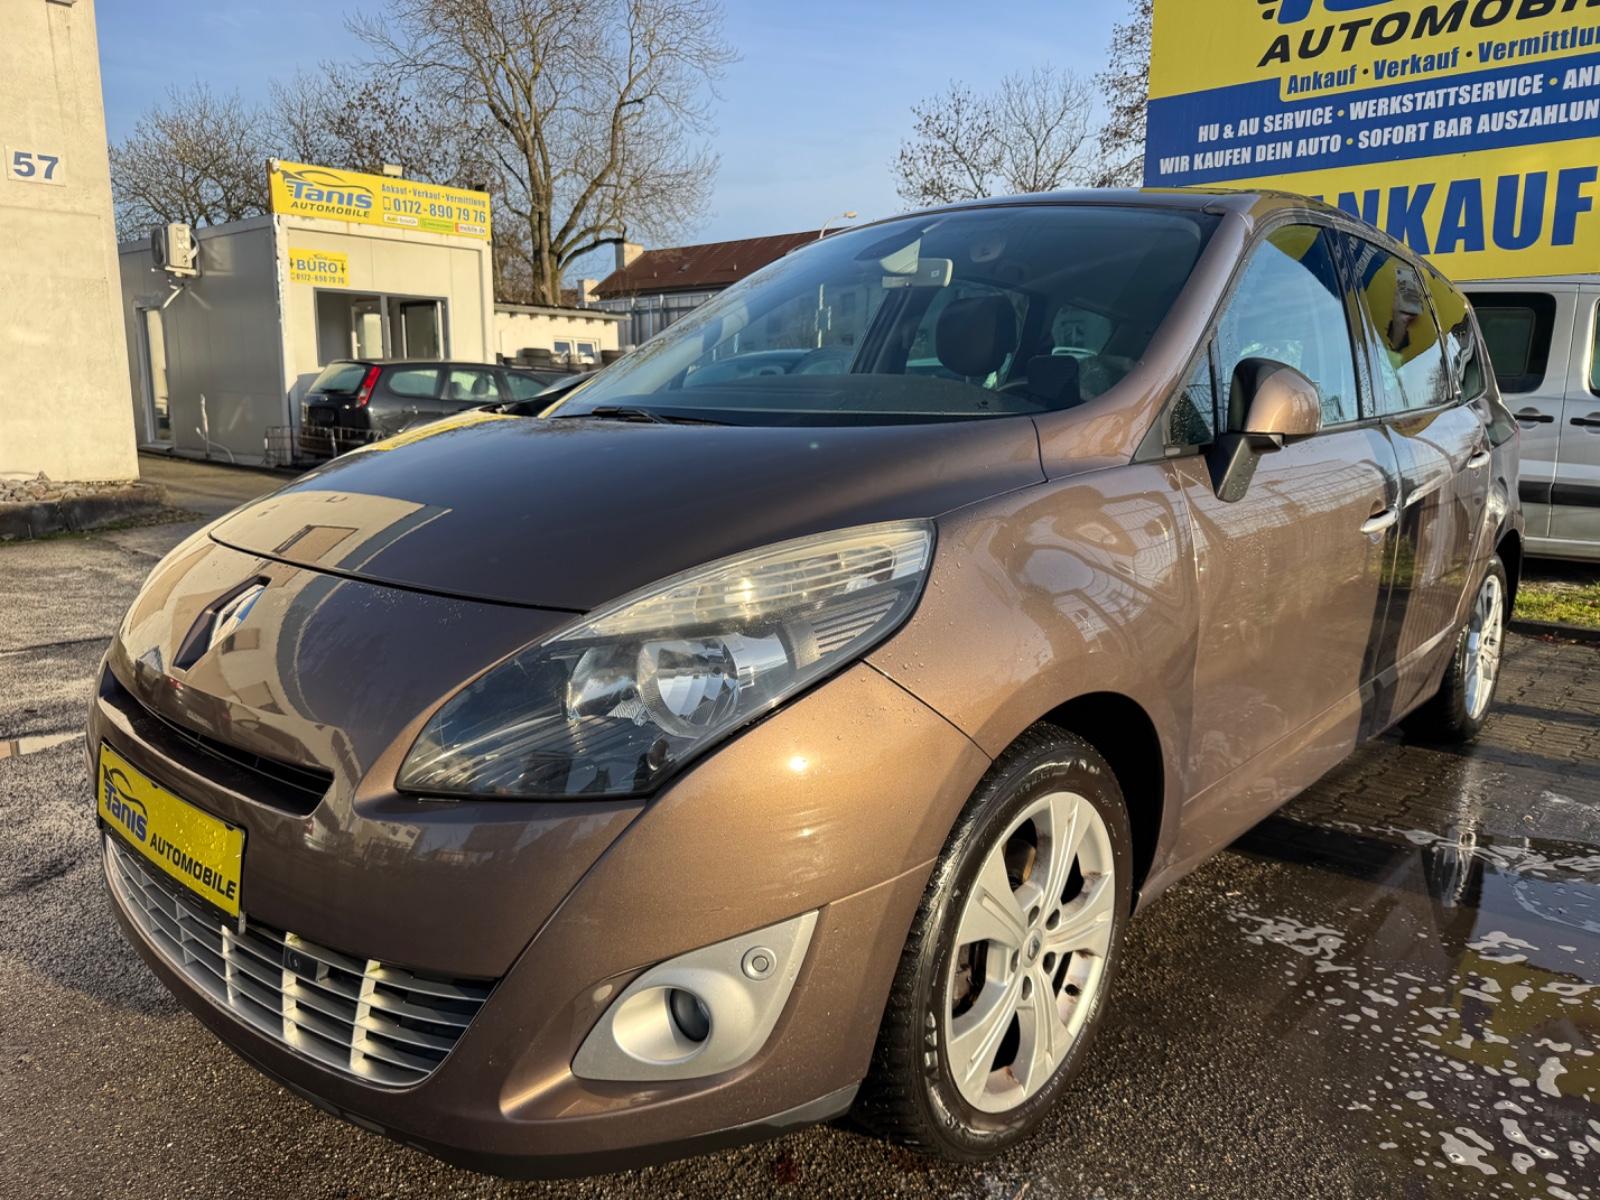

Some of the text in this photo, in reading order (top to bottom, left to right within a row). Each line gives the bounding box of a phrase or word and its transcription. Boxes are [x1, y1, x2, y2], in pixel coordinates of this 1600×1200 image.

[1287, 65, 1357, 95] Ankauf
[1374, 46, 1461, 80] Verkauf
[1198, 123, 1220, 143] HU
[1223, 124, 1235, 139] &
[1238, 117, 1260, 137] AU
[1263, 106, 1333, 134] SERVICE
[1348, 73, 1544, 121] WERKSTATTSERVICE
[1159, 155, 1190, 175] WIR
[1193, 146, 1252, 171] KAUFEN
[1255, 140, 1296, 162] DEIN
[1296, 134, 1342, 158] AUTO
[1357, 121, 1430, 150] SOFORT
[1433, 115, 1472, 140] BAR
[13, 151, 59, 180] 57
[286, 179, 373, 209] Tanis
[290, 200, 370, 218] AUTOMOBILE
[456, 207, 470, 222] 79
[473, 209, 486, 224] 76
[296, 257, 338, 274] BÜRO
[104, 779, 148, 843] Tanis
[150, 832, 237, 901] AUTOMOBILE
